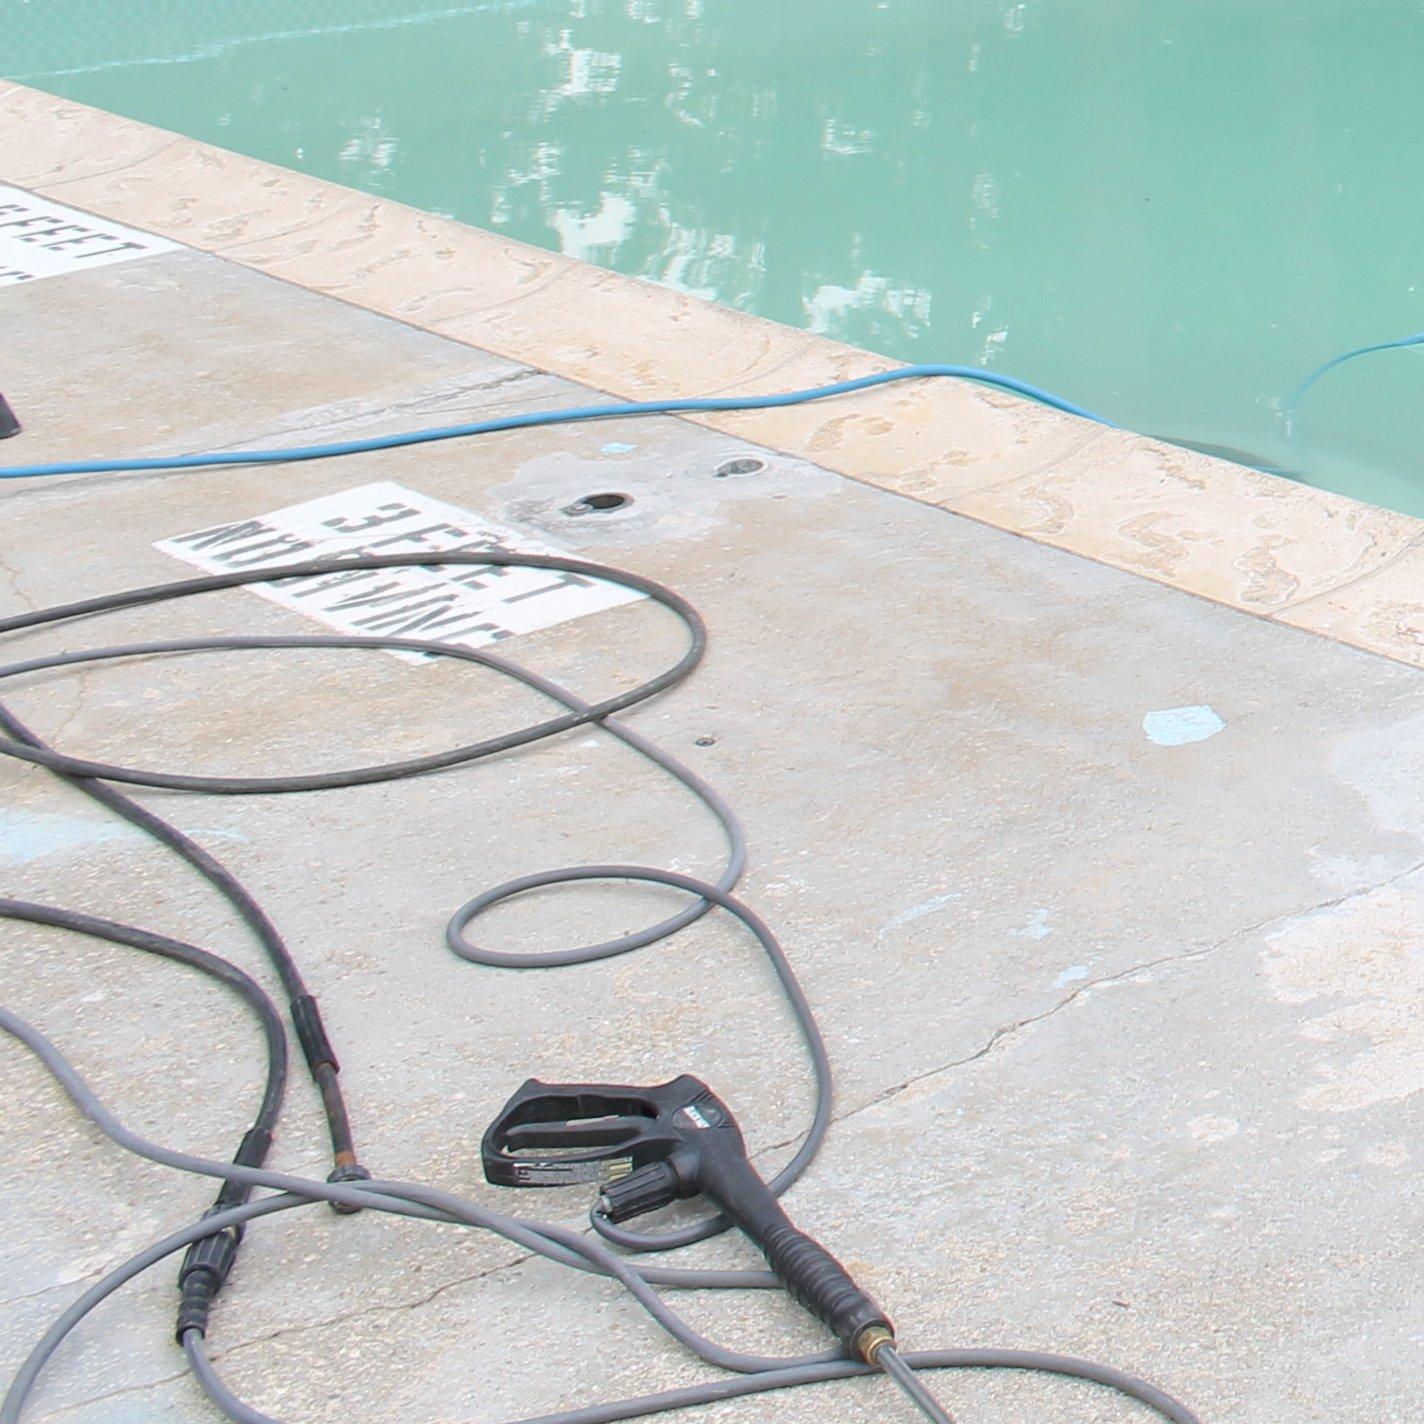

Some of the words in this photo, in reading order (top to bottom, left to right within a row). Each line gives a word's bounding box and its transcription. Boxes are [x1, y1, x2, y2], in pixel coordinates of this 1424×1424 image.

[0, 215, 147, 259] FEET
[323, 502, 422, 533] 3
[173, 519, 313, 568] NO
[369, 522, 595, 604] FEET
